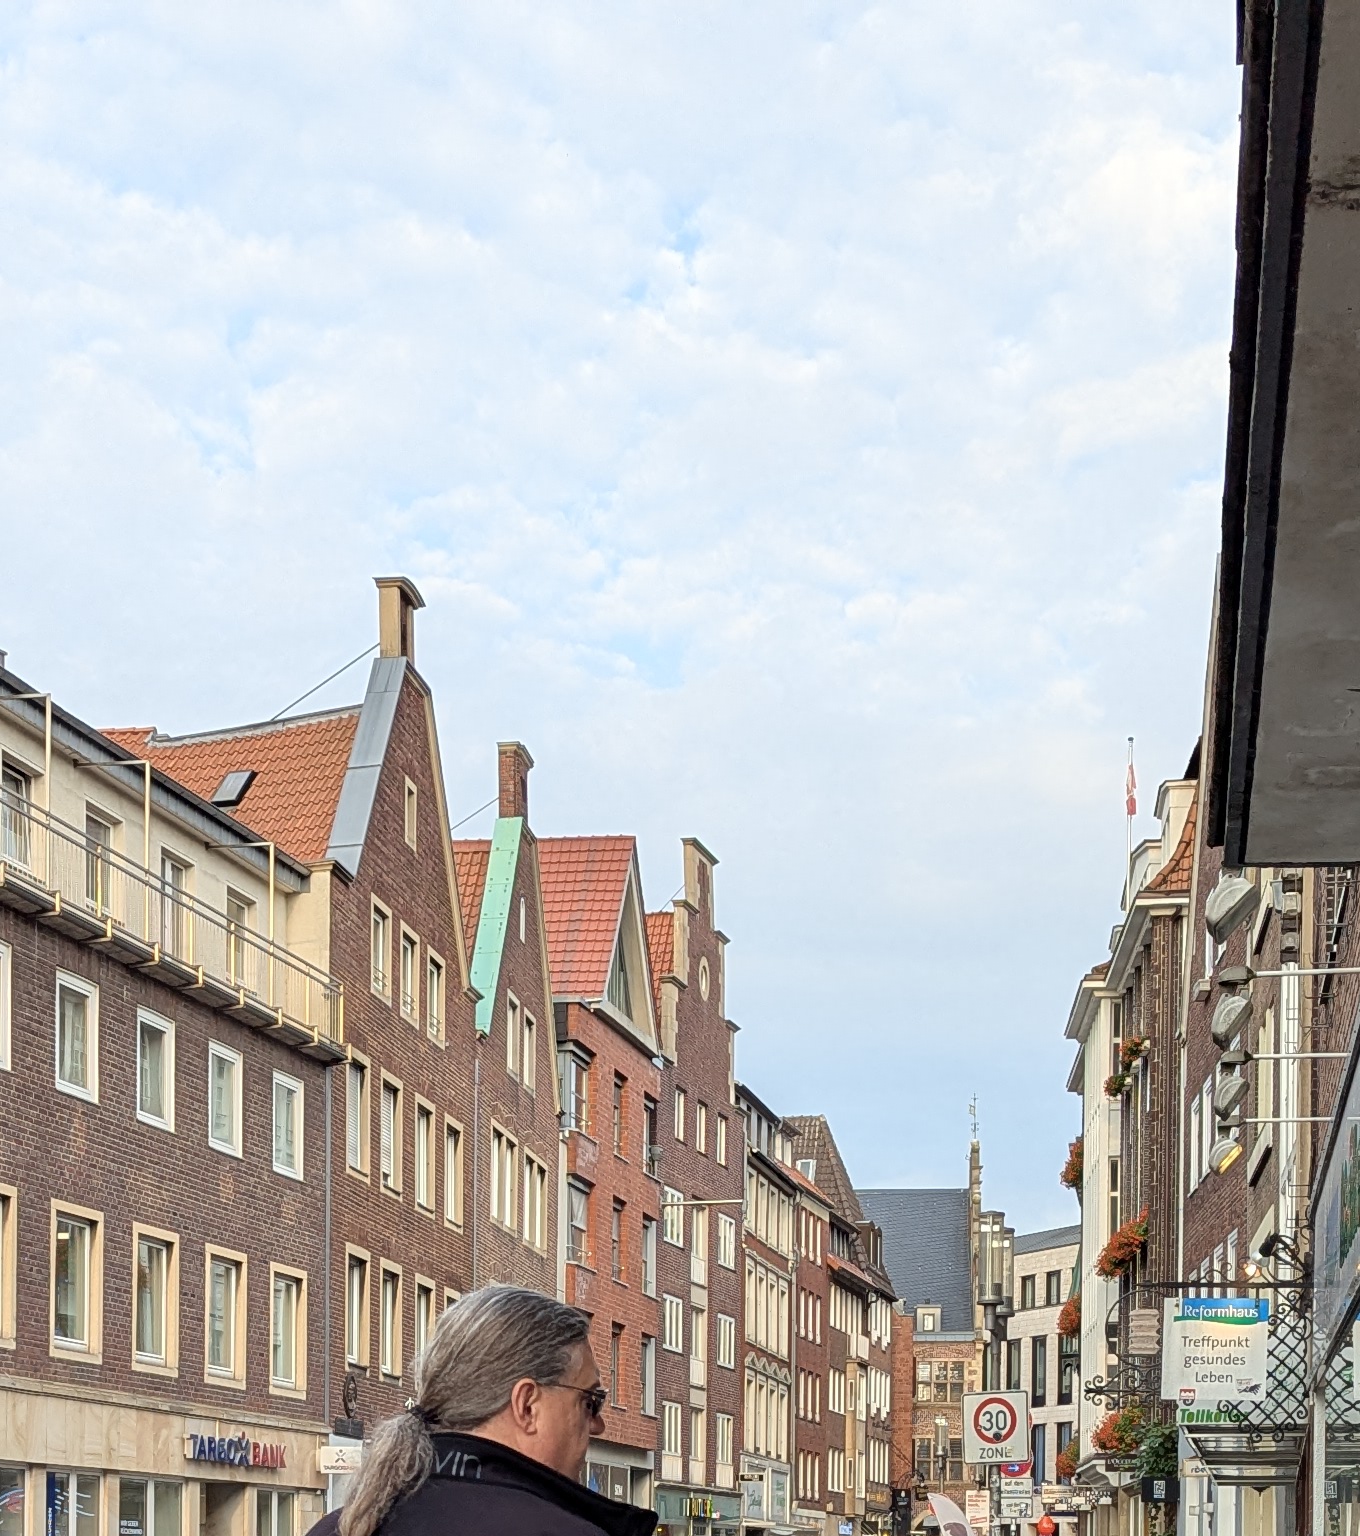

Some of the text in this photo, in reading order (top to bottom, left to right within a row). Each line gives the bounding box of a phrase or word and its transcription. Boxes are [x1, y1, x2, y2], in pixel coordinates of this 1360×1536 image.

[1184, 1305, 1258, 1320] Reformhaus
[1181, 1336, 1250, 1350] Treffpunkt
[1184, 1353, 1246, 1368] gesundes
[1196, 1371, 1233, 1383] Leben
[982, 1410, 1007, 1431] 30
[252, 1442, 287, 1469] BANK
[979, 1447, 1013, 1459] ZONE
